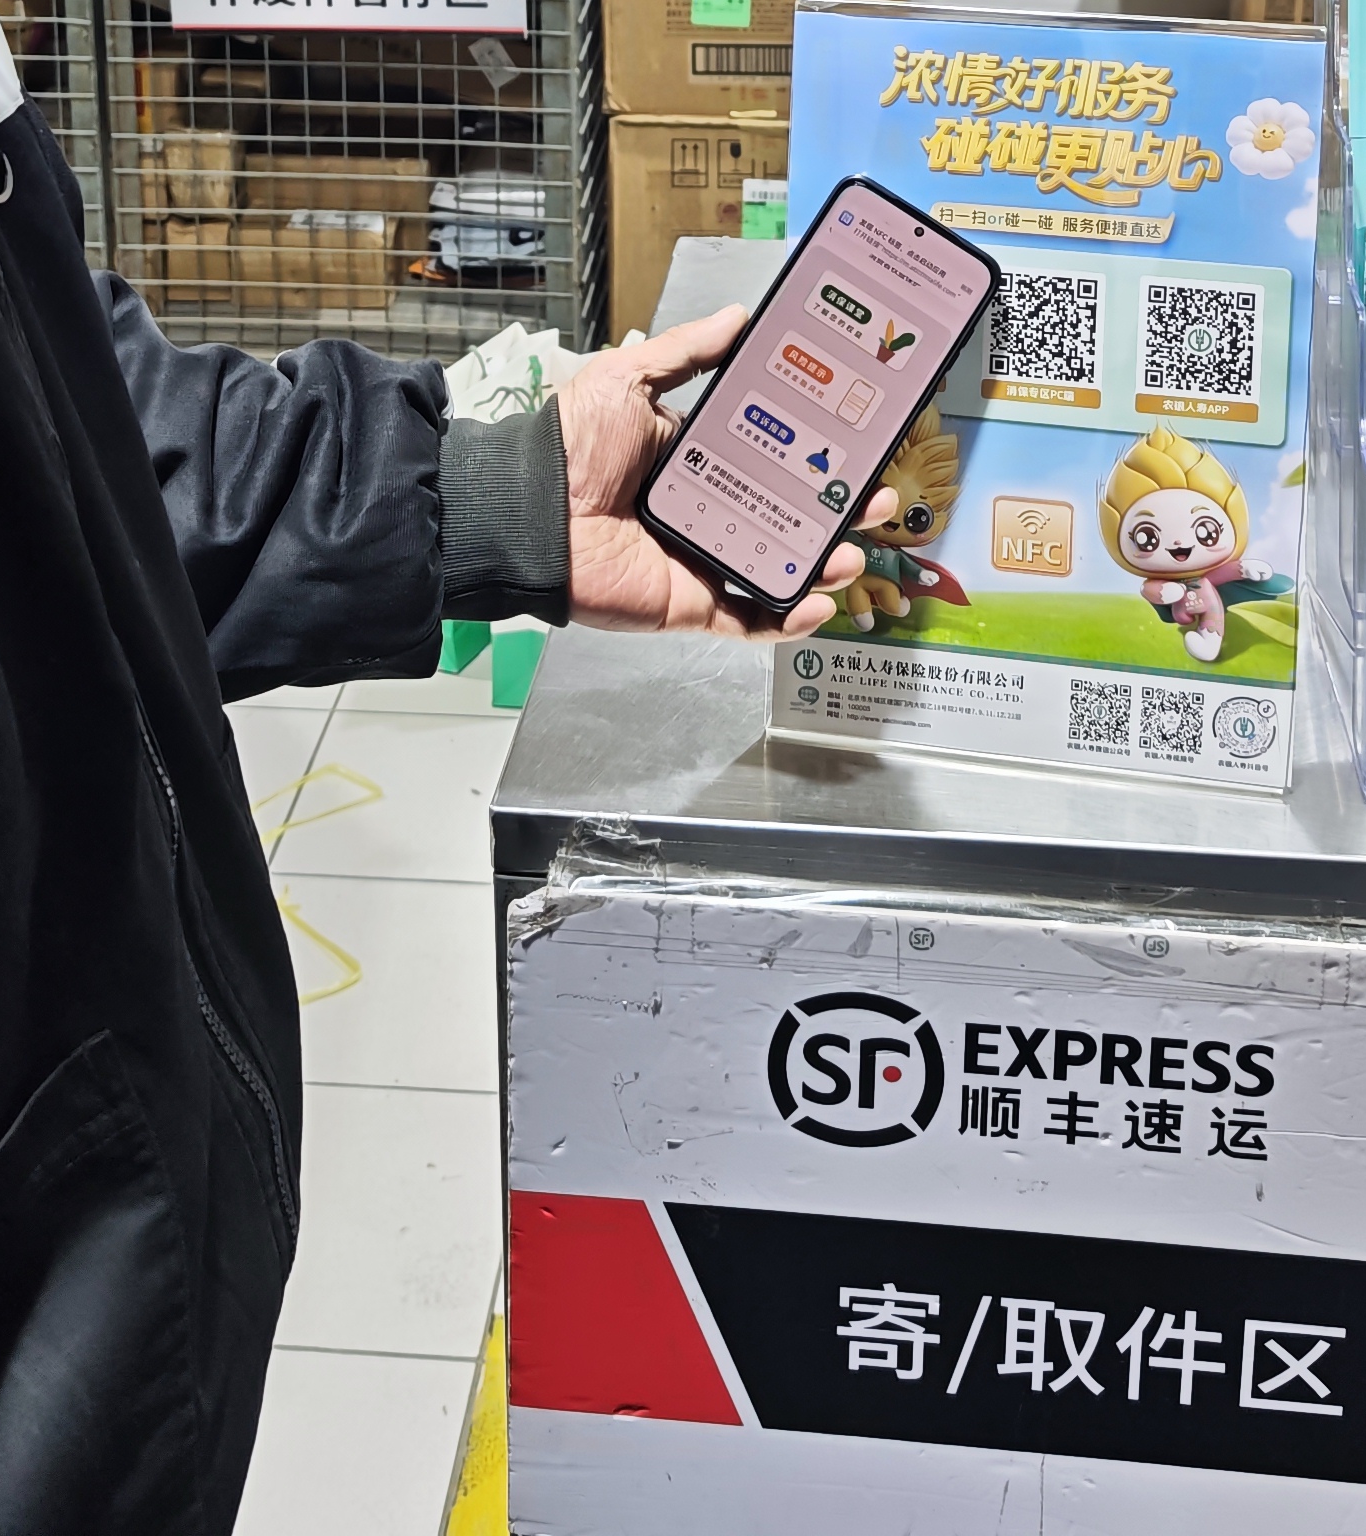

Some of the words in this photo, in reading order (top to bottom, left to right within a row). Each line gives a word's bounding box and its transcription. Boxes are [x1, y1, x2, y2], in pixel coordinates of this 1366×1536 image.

[879, 44, 1178, 123] 浓情好服务
[921, 116, 1222, 206] 碰碰更贴心
[872, 227, 888, 241] NFC
[938, 207, 1054, 231] 扫一扫or碰一碰
[1061, 215, 1162, 239] 服务便捷直达
[1005, 385, 1075, 403] 消保专区PC端
[1162, 398, 1230, 416] 农银人寿APP
[1001, 535, 1063, 567] NFC
[830, 653, 1026, 691] 农银人寿保险股份有限公司
[830, 673, 854, 684] ABC
[859, 676, 888, 688] LIFE
[893, 680, 965, 697] INSURANCE
[962, 1024, 1276, 1098] EXPRESS
[958, 1087, 1269, 1161] 顺丰速运
[836, 1282, 1346, 1418] 寄/取件区
